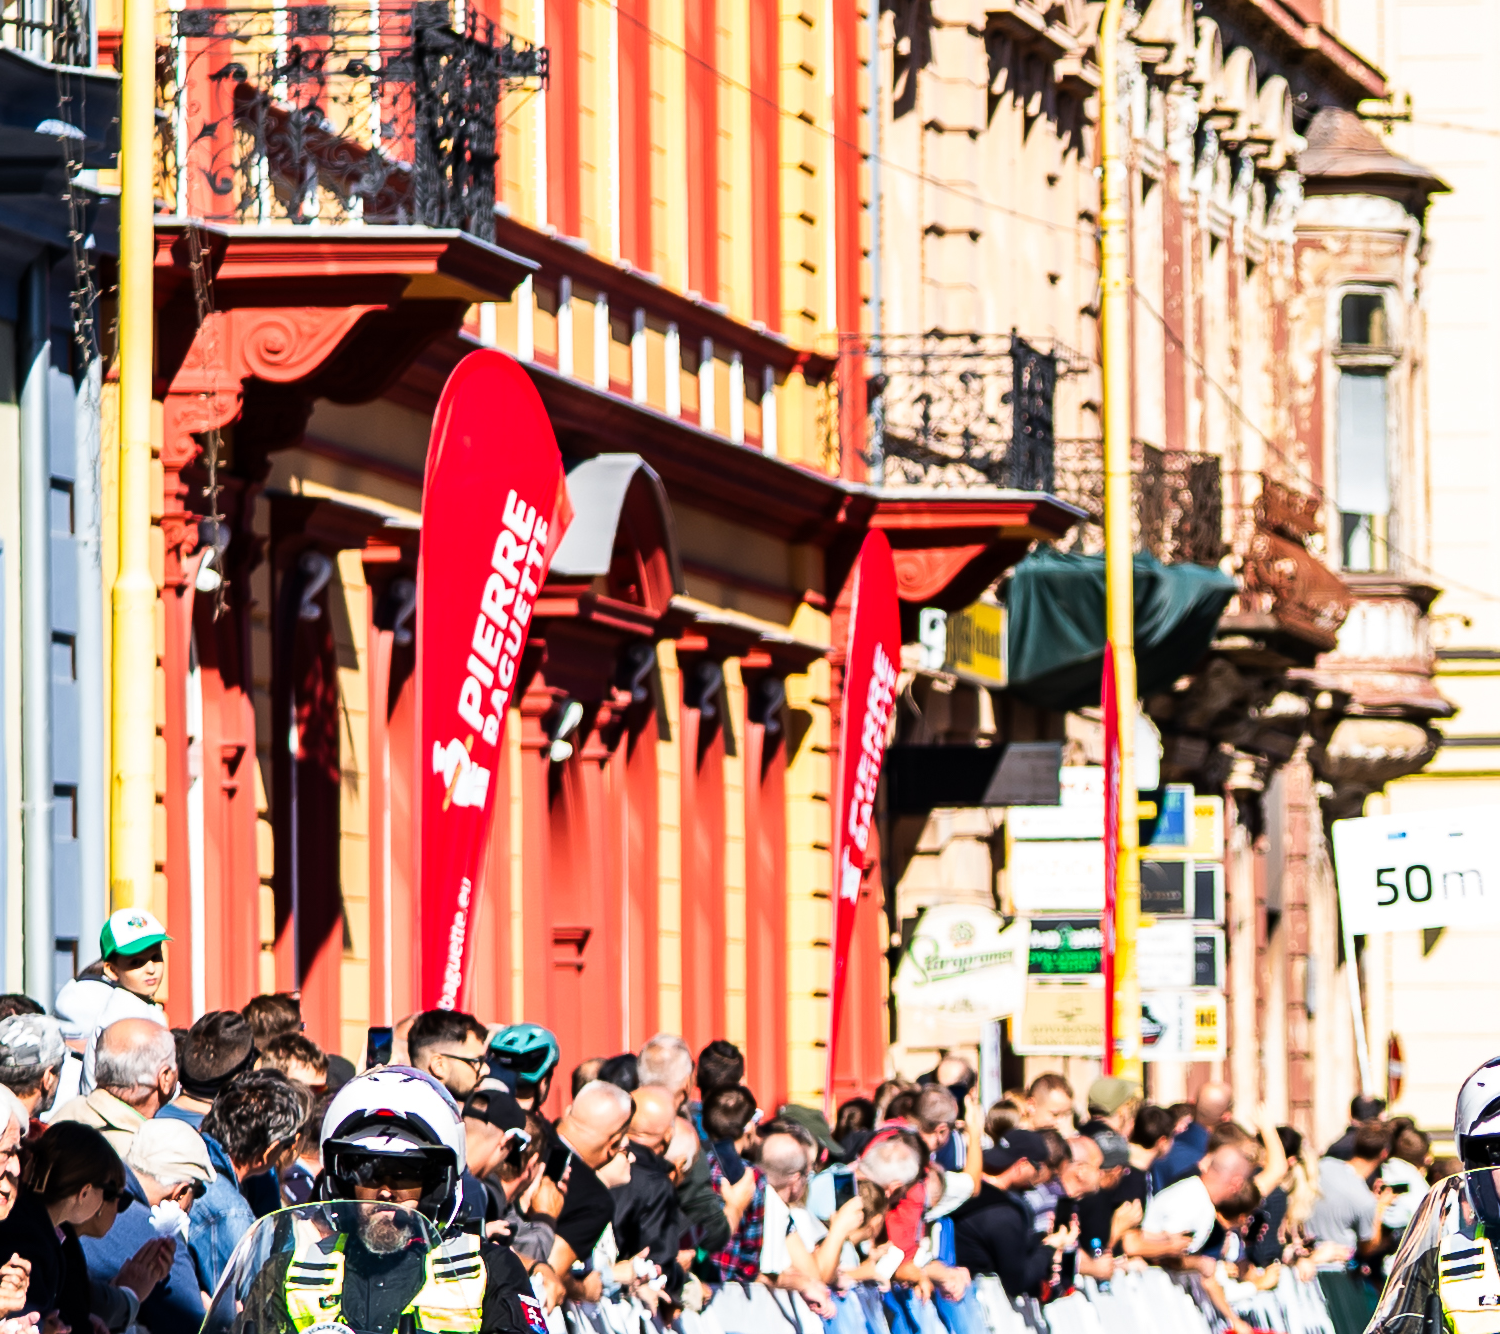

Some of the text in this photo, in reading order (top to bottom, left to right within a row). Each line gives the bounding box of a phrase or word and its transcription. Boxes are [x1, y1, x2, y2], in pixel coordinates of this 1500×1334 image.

[457, 489, 537, 733] PIERRE
[1376, 864, 1484, 906] 50 m
